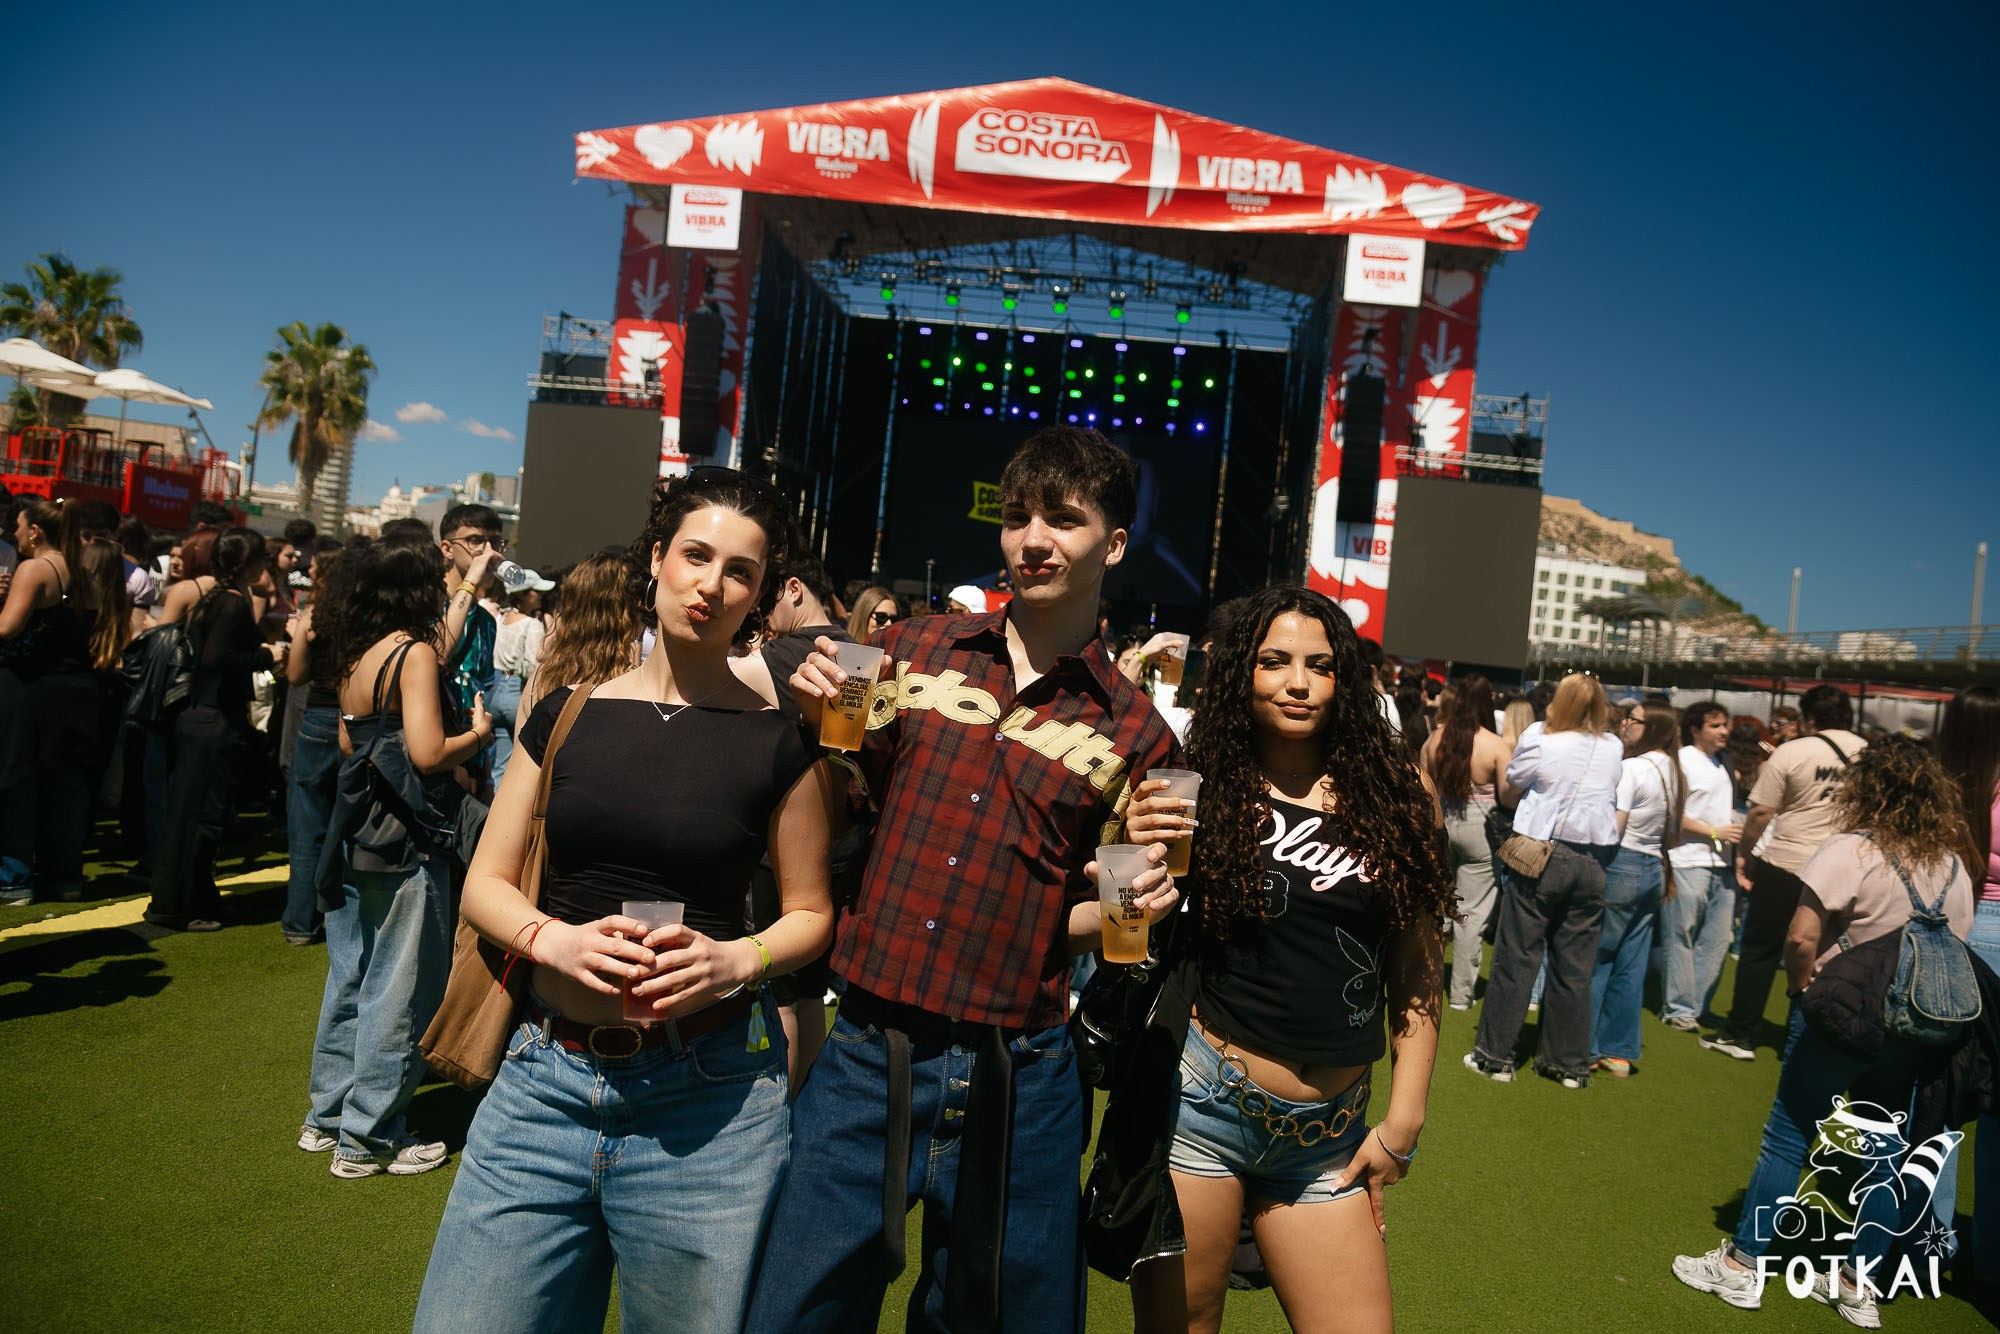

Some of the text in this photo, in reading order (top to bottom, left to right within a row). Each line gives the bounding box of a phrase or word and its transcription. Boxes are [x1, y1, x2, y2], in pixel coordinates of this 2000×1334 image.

[978, 110, 1098, 139] COSTA
[787, 121, 890, 161] VIBRA
[974, 133, 1127, 165] SONORA
[1197, 155, 1304, 194] VIBRA
[685, 213, 726, 227] VIBRA
[1363, 268, 1407, 282] VIBRA
[1352, 536, 1387, 556] VIB
[1254, 802, 1378, 892] Play
